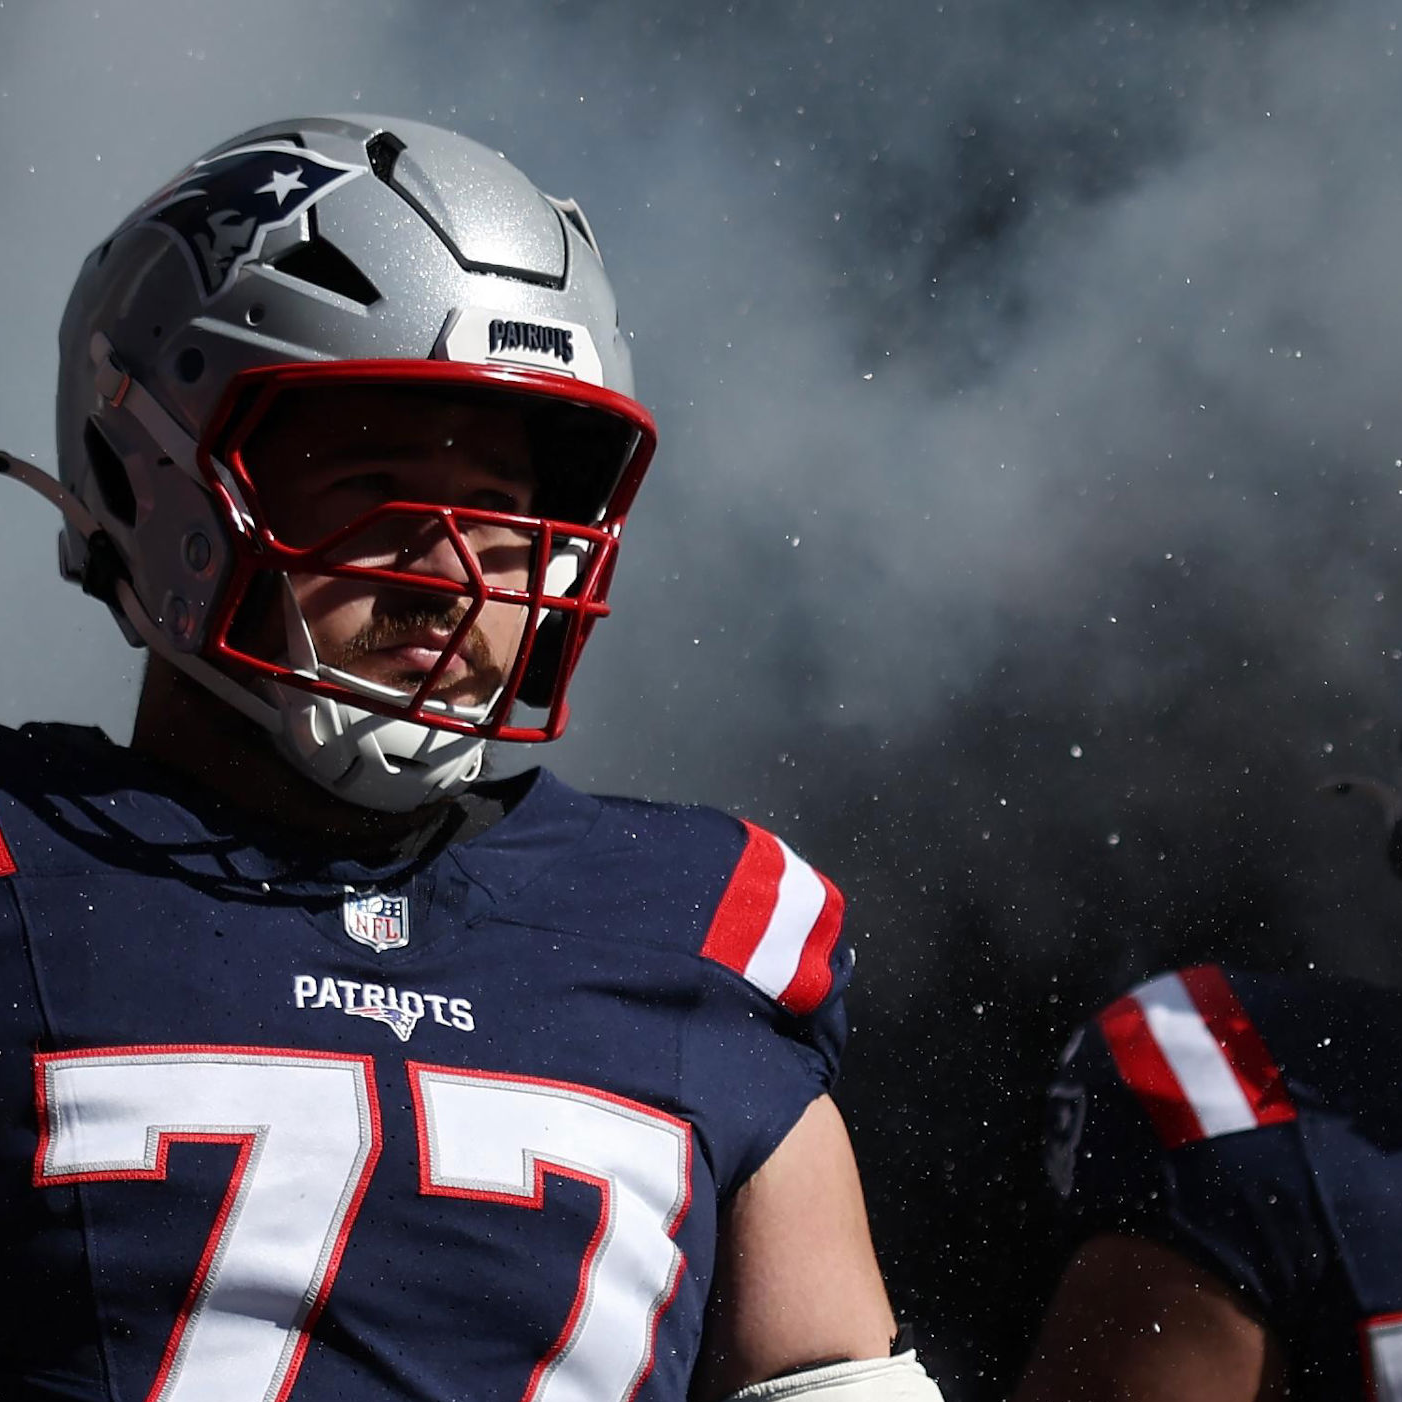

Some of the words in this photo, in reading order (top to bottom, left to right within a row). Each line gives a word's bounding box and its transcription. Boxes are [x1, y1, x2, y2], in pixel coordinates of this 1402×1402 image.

[488, 318, 574, 364] PATRIOTS
[355, 915, 399, 940] NFL
[294, 975, 476, 1032] PATRIOTS
